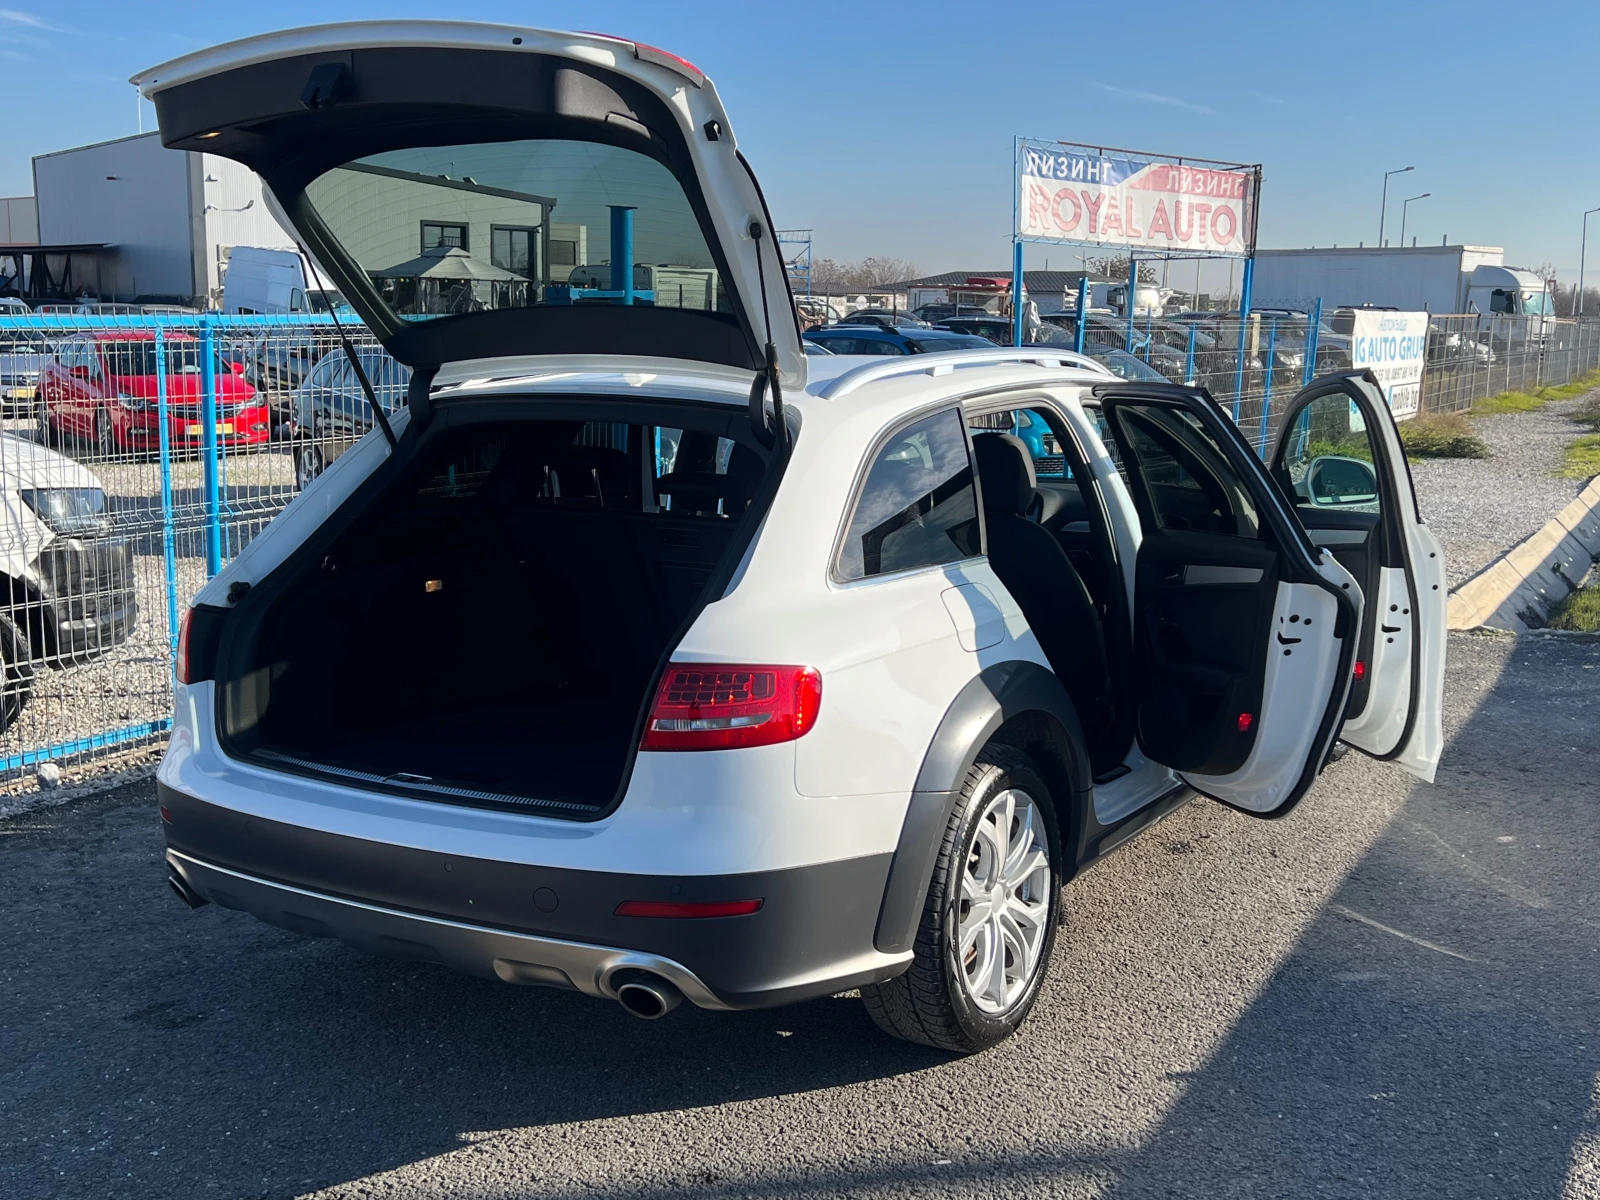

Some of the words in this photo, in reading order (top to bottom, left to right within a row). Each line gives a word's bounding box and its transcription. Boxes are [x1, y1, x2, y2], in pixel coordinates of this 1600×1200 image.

[1026, 151, 1112, 182] ЛИЗИНГ
[1166, 170, 1244, 196] ЛИЗИНГ
[1029, 183, 1142, 238] ROYAL
[1148, 198, 1237, 245] AUTO
[1355, 336, 1365, 363] IG
[1368, 336, 1396, 361] AUTO
